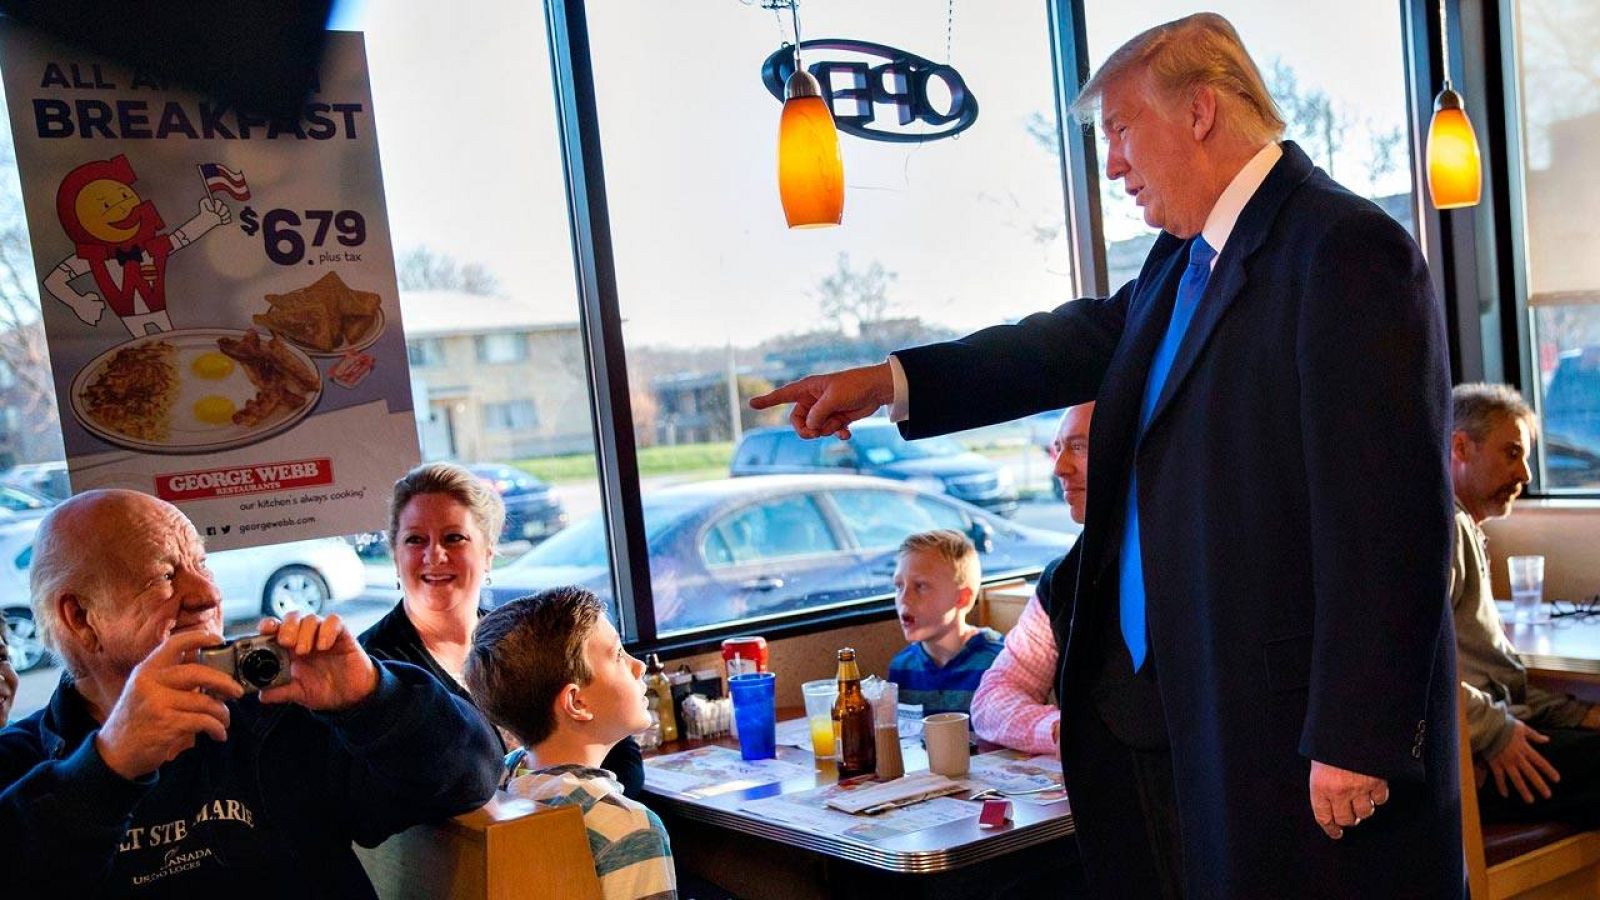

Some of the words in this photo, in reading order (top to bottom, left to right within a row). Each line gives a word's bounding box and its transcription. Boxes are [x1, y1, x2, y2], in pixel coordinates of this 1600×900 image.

[41, 63, 116, 89] ALL
[319, 251, 341, 265] plus
[344, 252, 362, 262] tax
[168, 469, 252, 492] GEORGE
[256, 462, 319, 483] WEBB
[215, 482, 281, 496] RESTAURANTS
[239, 503, 255, 512] our
[257, 494, 299, 509] kitchen's
[300, 494, 329, 506] always
[239, 516, 316, 534] georgewebb.com
[149, 819, 188, 846] STE
